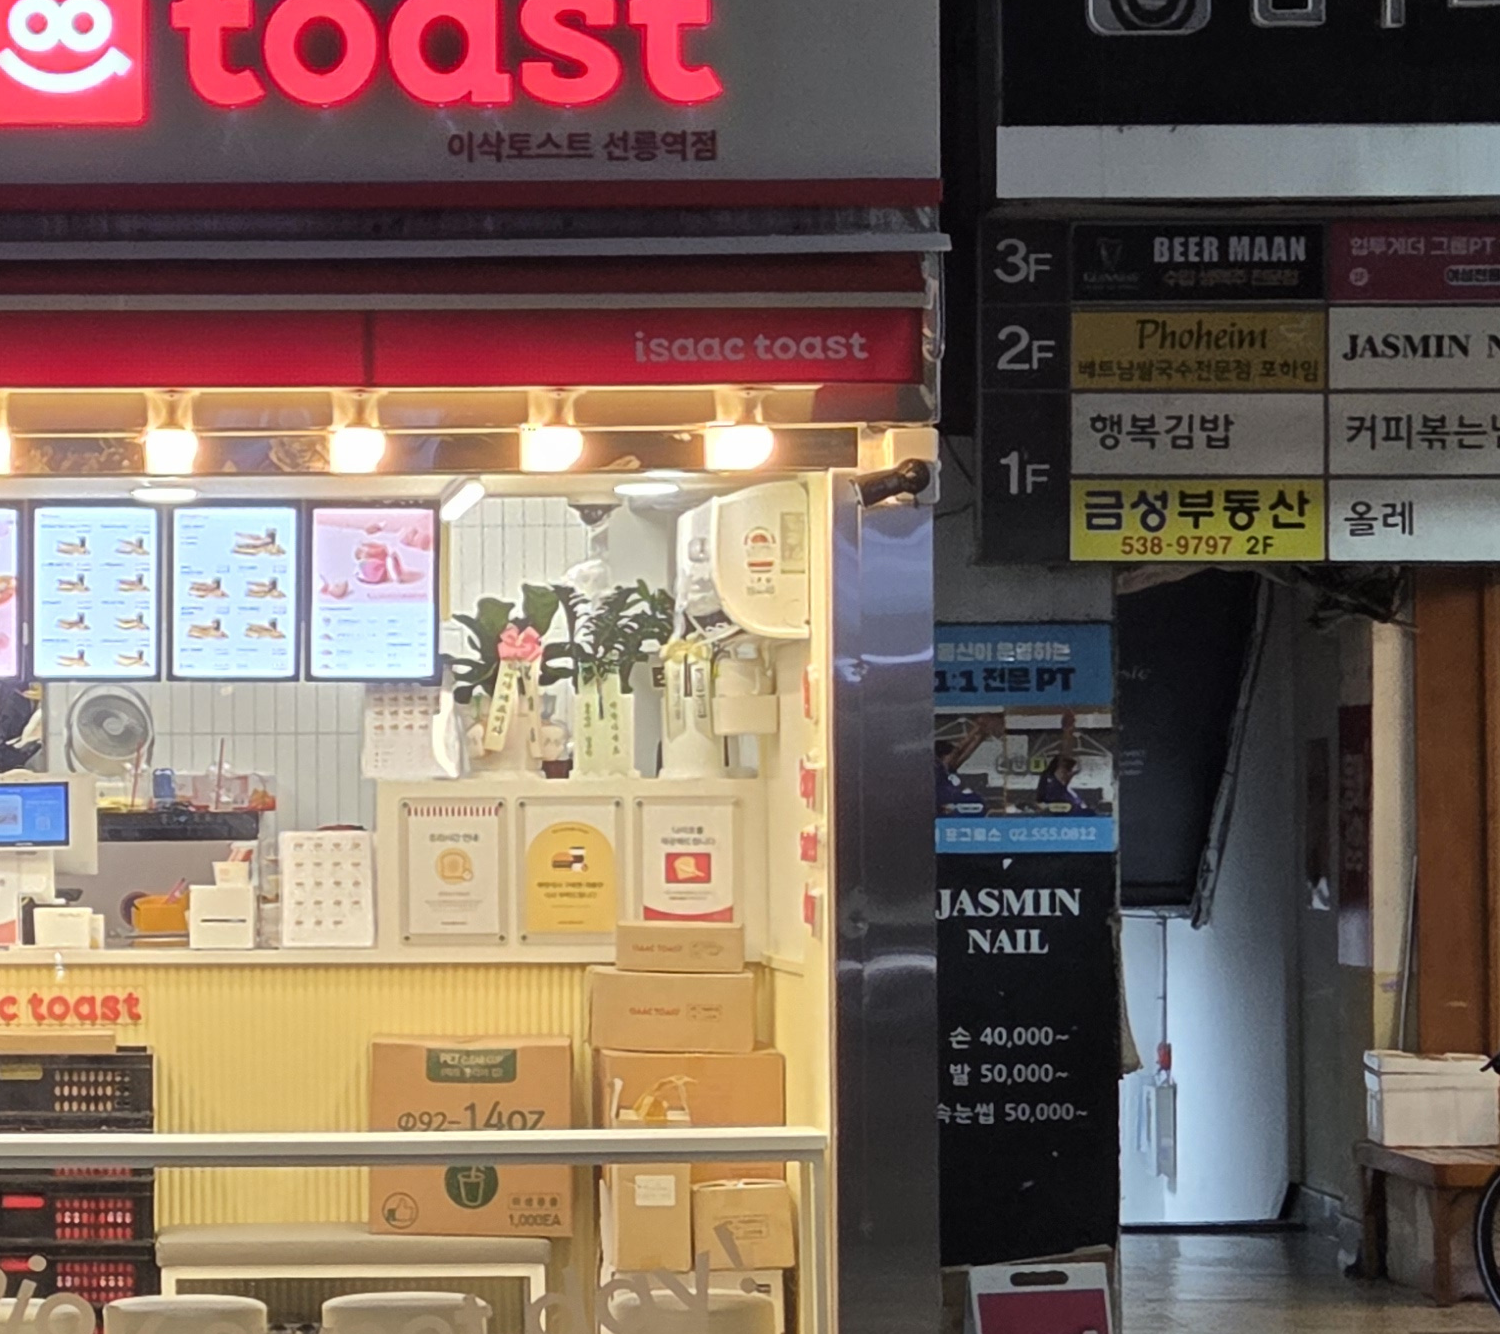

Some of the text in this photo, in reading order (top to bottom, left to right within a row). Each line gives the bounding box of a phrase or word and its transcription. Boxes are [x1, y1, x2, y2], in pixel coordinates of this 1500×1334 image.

[447, 130, 717, 162] 이삭토스트 선릉역점
[994, 238, 1052, 283] 3F
[1153, 236, 1306, 263] BEER MAAN
[635, 331, 869, 363] isaac toast
[997, 324, 1055, 370] 2F
[1136, 319, 1268, 352] Phoheim
[1342, 335, 1471, 361] JASMIN
[1260, 359, 1319, 383] 포하임
[1089, 414, 1235, 451] 행복김밥
[1000, 450, 1050, 495] 1F
[1084, 489, 1311, 533] 금성부동산
[1343, 501, 1415, 536] 올레
[1120, 535, 1275, 555] 538-9797 2F
[935, 888, 1081, 919] JASMIN
[967, 929, 1049, 954] NAIL
[28, 992, 142, 1022] toast
[948, 1026, 1069, 1049] 손 40,000~
[949, 1063, 1069, 1086] 발 50,000~
[936, 1102, 1088, 1125] 속눈썹 50,000~
